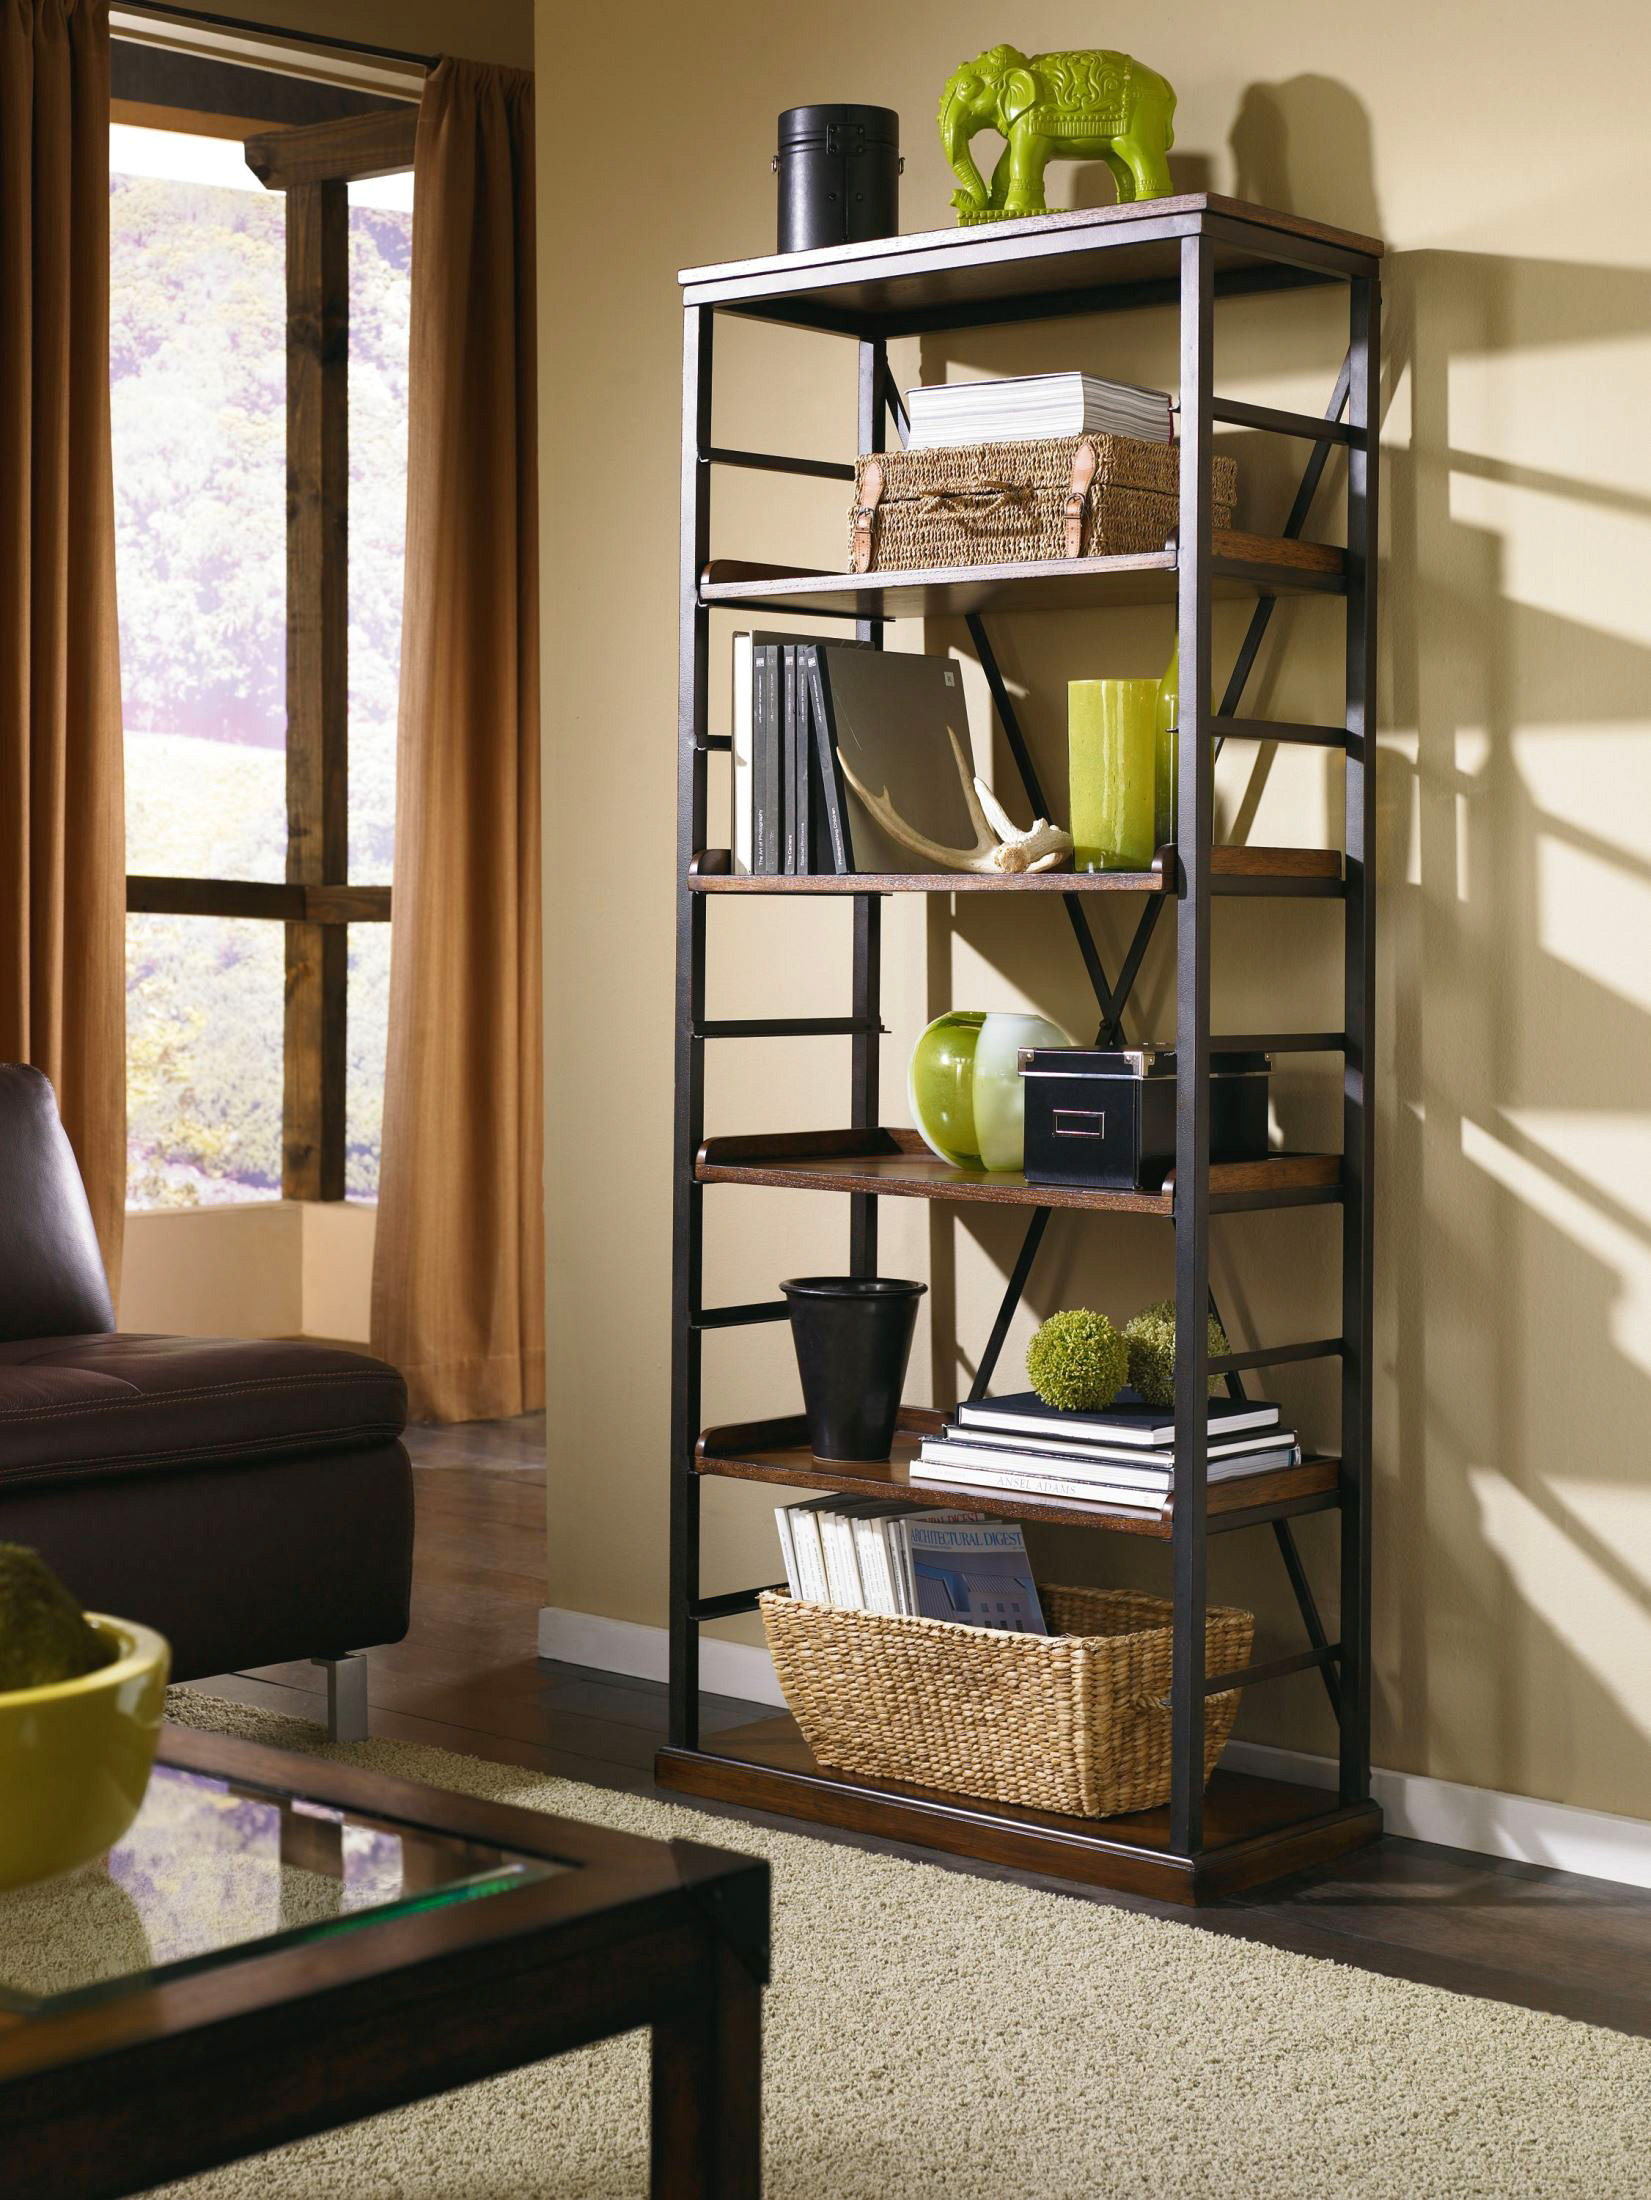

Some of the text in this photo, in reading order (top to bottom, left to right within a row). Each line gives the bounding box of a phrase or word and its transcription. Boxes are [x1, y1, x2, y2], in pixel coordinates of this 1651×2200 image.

[997, 1476, 1077, 1495] ANSEL ADAMS
[911, 1528, 1022, 1547] ARCHITECTURAL DIGEST
